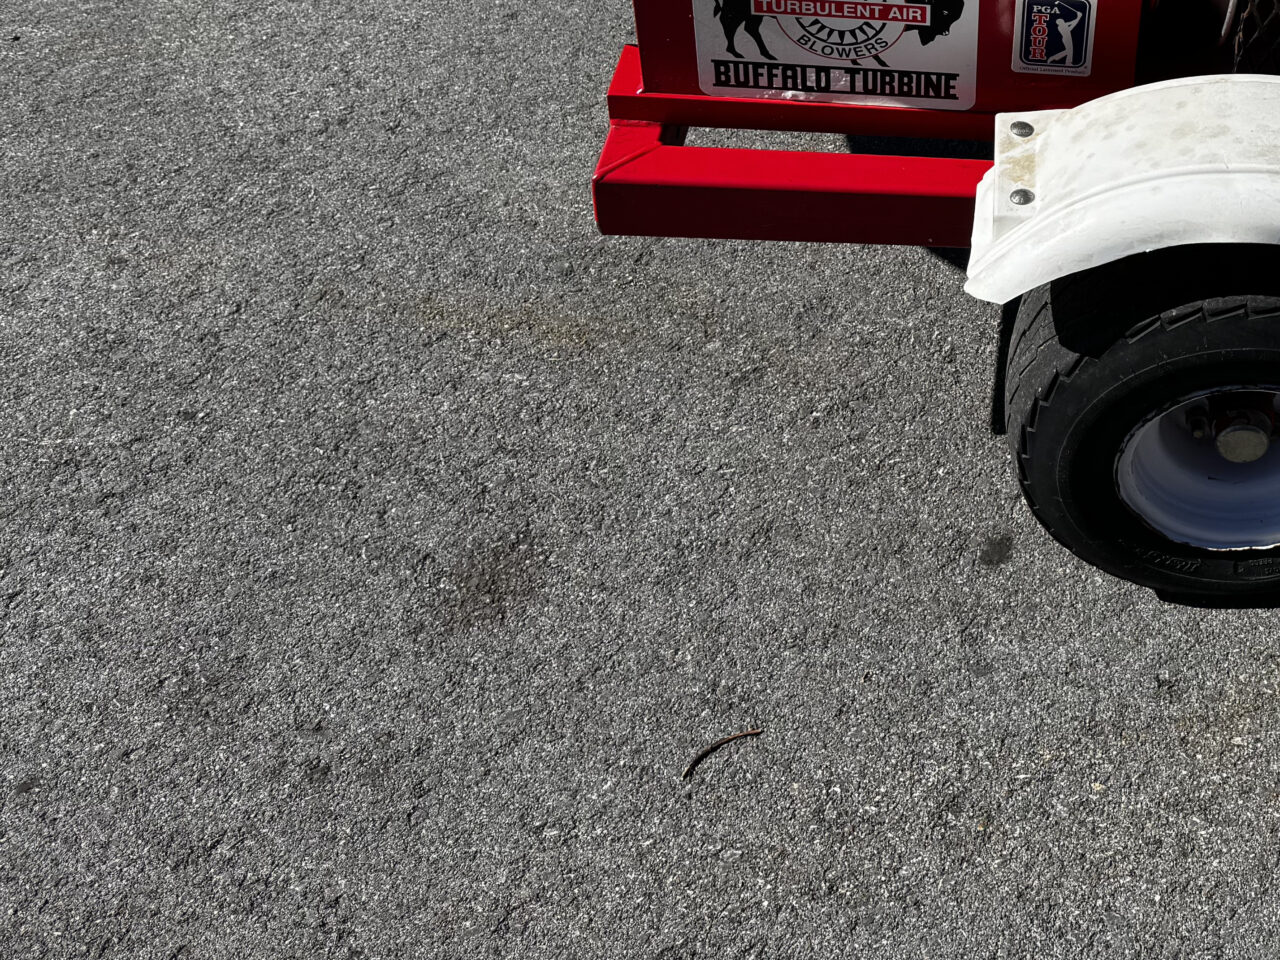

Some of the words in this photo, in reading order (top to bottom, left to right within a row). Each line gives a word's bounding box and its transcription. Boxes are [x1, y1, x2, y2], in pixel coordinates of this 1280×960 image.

[888, 5, 923, 21] AIR
[1032, 5, 1060, 14] PGA
[796, 34, 889, 59] BLOWERS
[1029, 13, 1050, 60] TOUR
[711, 58, 832, 92] BUFFALO
[843, 68, 960, 100] TURBINE
